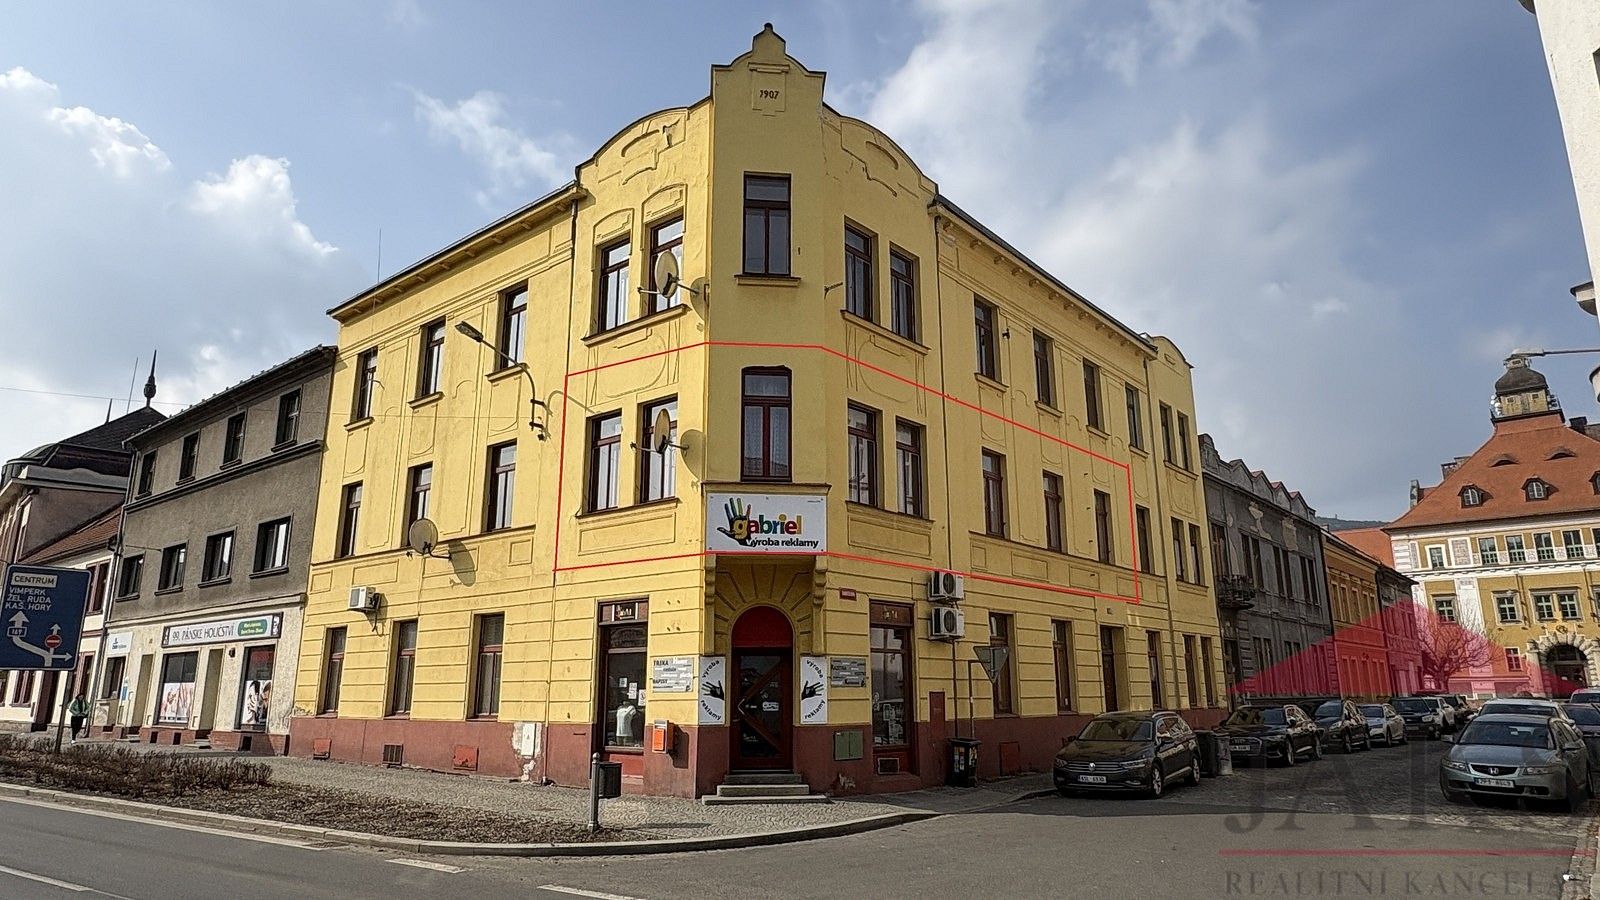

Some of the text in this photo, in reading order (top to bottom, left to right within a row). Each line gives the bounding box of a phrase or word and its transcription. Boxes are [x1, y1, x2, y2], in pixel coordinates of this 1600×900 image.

[760, 90, 779, 99] 1907
[732, 514, 803, 540] gabriel
[745, 537, 819, 549] výroba reklamy
[14, 575, 55, 585] CENTRUM
[9, 587, 46, 595] VIMPERK
[28, 603, 52, 611] HORY
[700, 700, 722, 721] reklamy
[804, 699, 826, 719] reklamy
